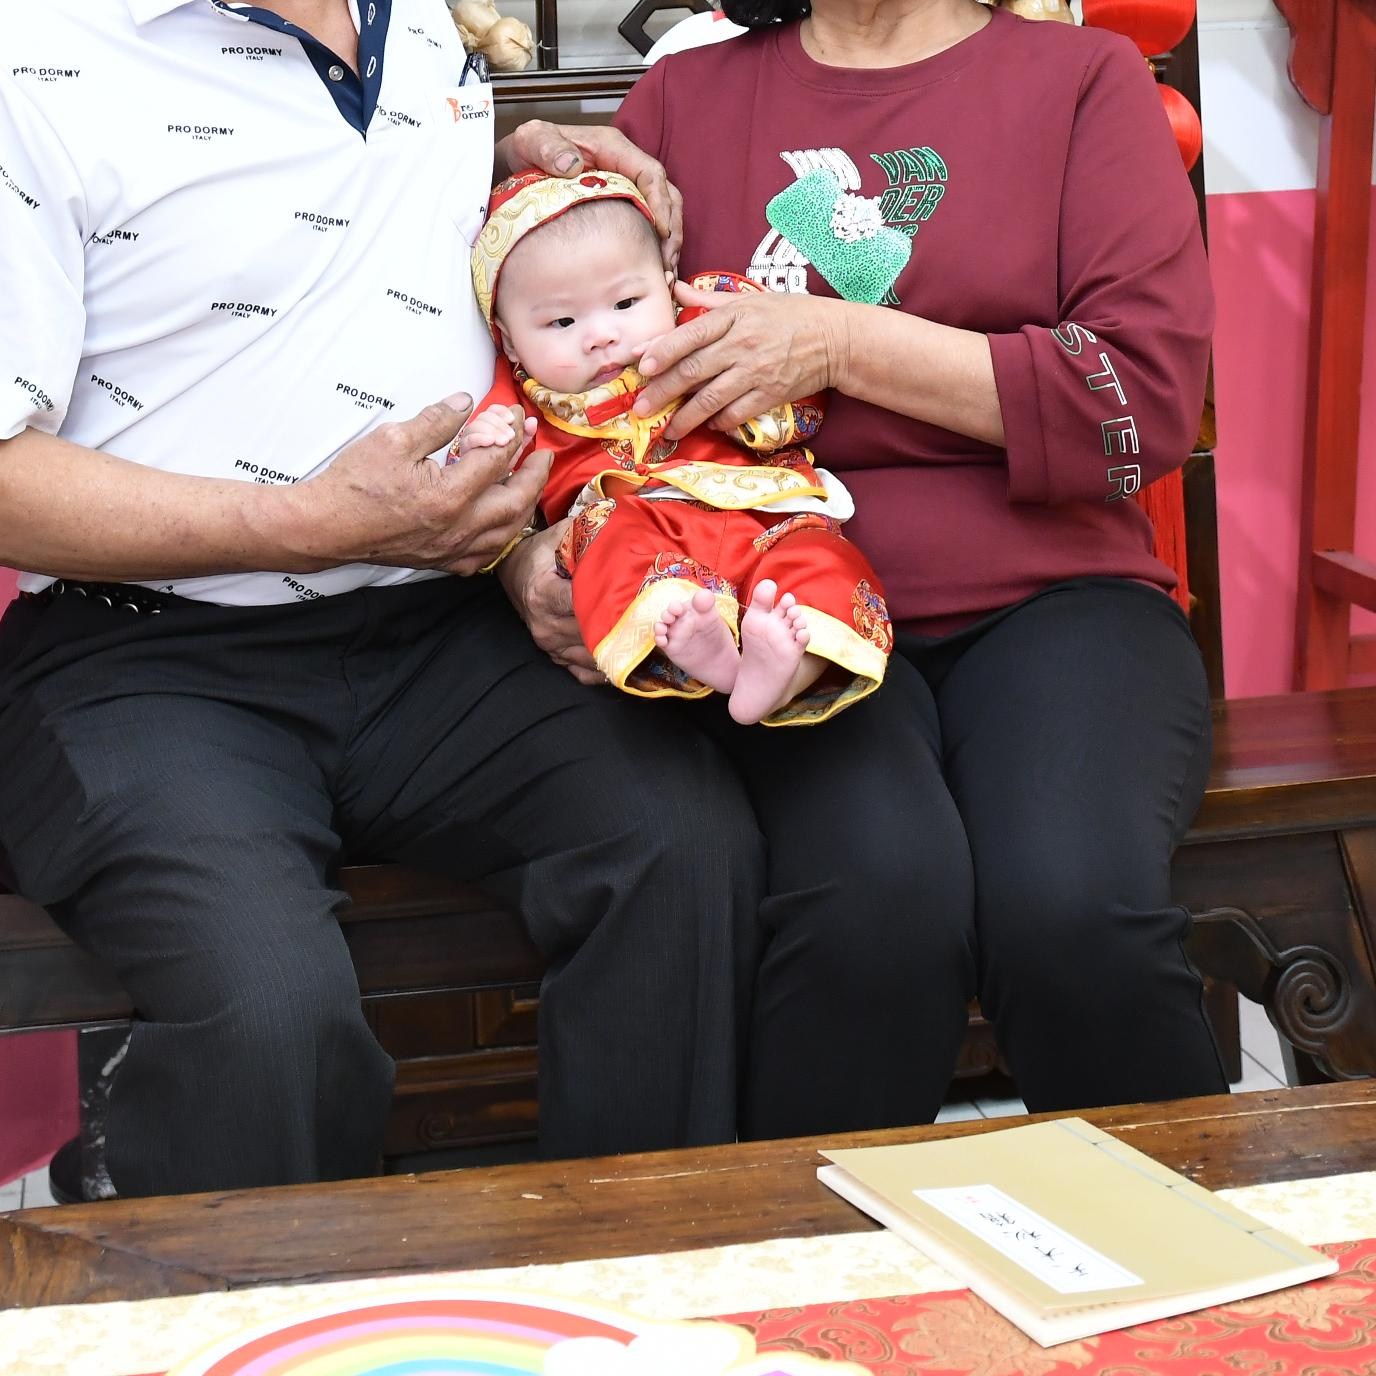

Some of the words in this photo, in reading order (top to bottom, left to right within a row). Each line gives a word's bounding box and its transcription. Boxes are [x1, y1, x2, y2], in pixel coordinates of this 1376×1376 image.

[221, 47, 244, 55] PRO
[245, 47, 283, 57] DORMY
[12, 66, 37, 77] PRO
[39, 68, 81, 78] DORMY
[167, 124, 192, 133] PRO
[194, 125, 235, 136] DORMY
[870, 146, 948, 186] VAN
[294, 211, 316, 222] PRO
[316, 214, 351, 228] DORMY
[312, 225, 329, 233] ITALY
[211, 302, 235, 311] PRO
[236, 302, 278, 317] DORMY
[387, 288, 408, 303] PRO
[409, 297, 443, 317] DORMY
[231, 311, 251, 319] ITALY
[405, 305, 422, 316] ITALY
[14, 376, 37, 393] PRO
[90, 374, 113, 390] PRO
[114, 386, 144, 411] DORMY
[109, 393, 125, 407] ITALY
[336, 383, 359, 397] PRO
[360, 391, 396, 411] DORMY
[354, 400, 374, 410] ITALY
[1051, 323, 1141, 502] STER
[234, 459, 259, 474] PRO
[260, 467, 300, 484] DORMY
[282, 576, 305, 592] PRO
